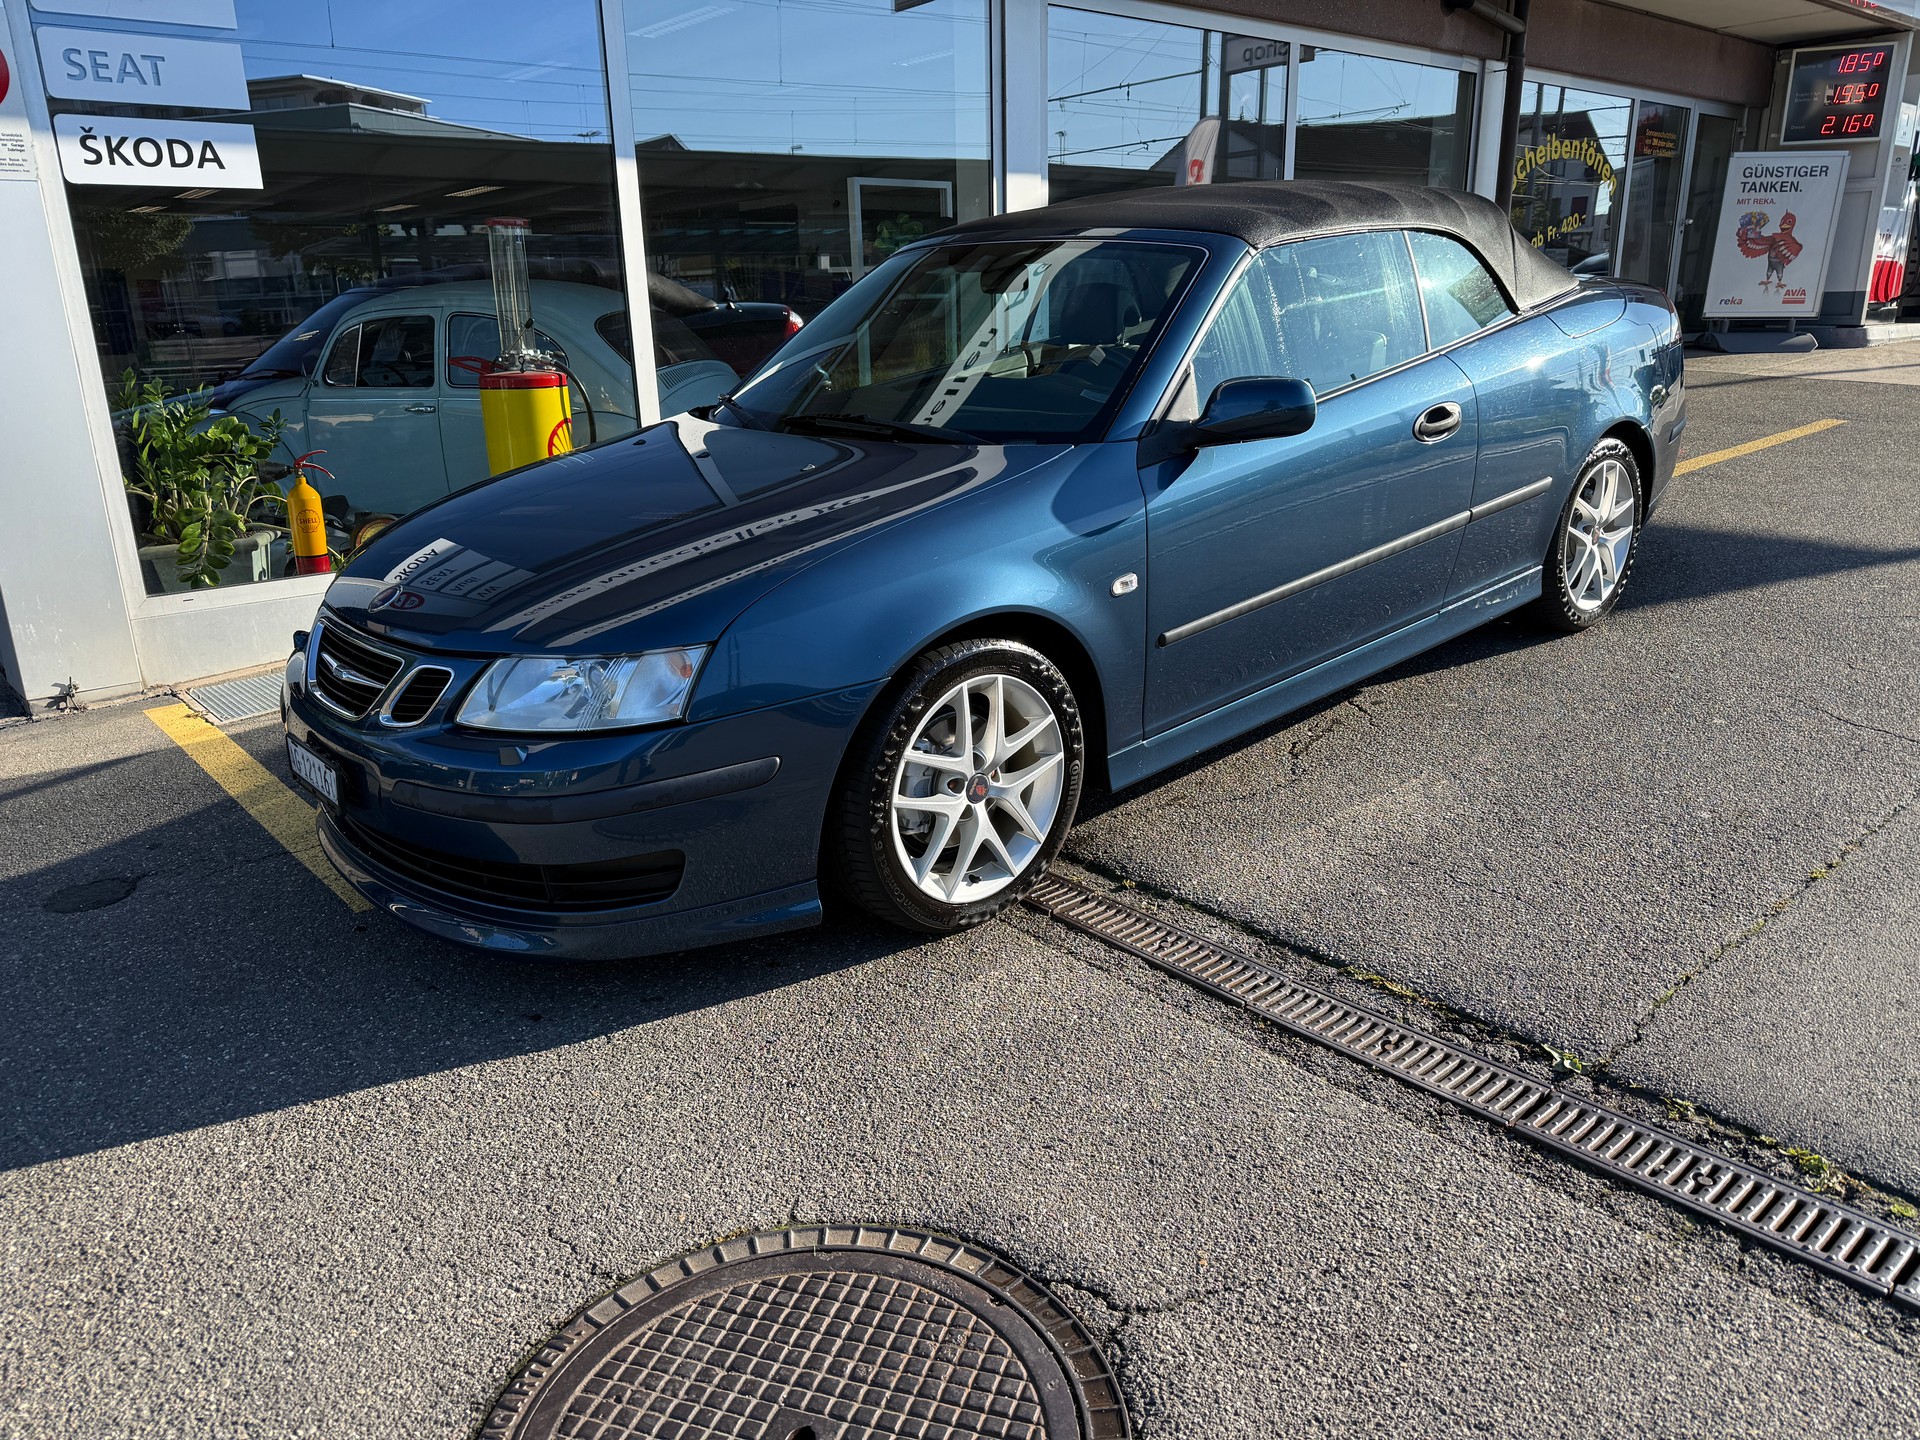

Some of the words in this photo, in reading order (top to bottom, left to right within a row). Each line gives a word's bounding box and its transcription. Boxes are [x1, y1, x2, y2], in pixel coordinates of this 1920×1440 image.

[62, 48, 166, 87] SEAT
[79, 126, 226, 170] ŠKODA
[1743, 164, 1829, 179] GÜNSTIGER
[1740, 181, 1802, 193] TANKEN.
[1783, 287, 1807, 297] AVIA
[1719, 297, 1743, 305] reka
[299, 517, 318, 525] SHELL
